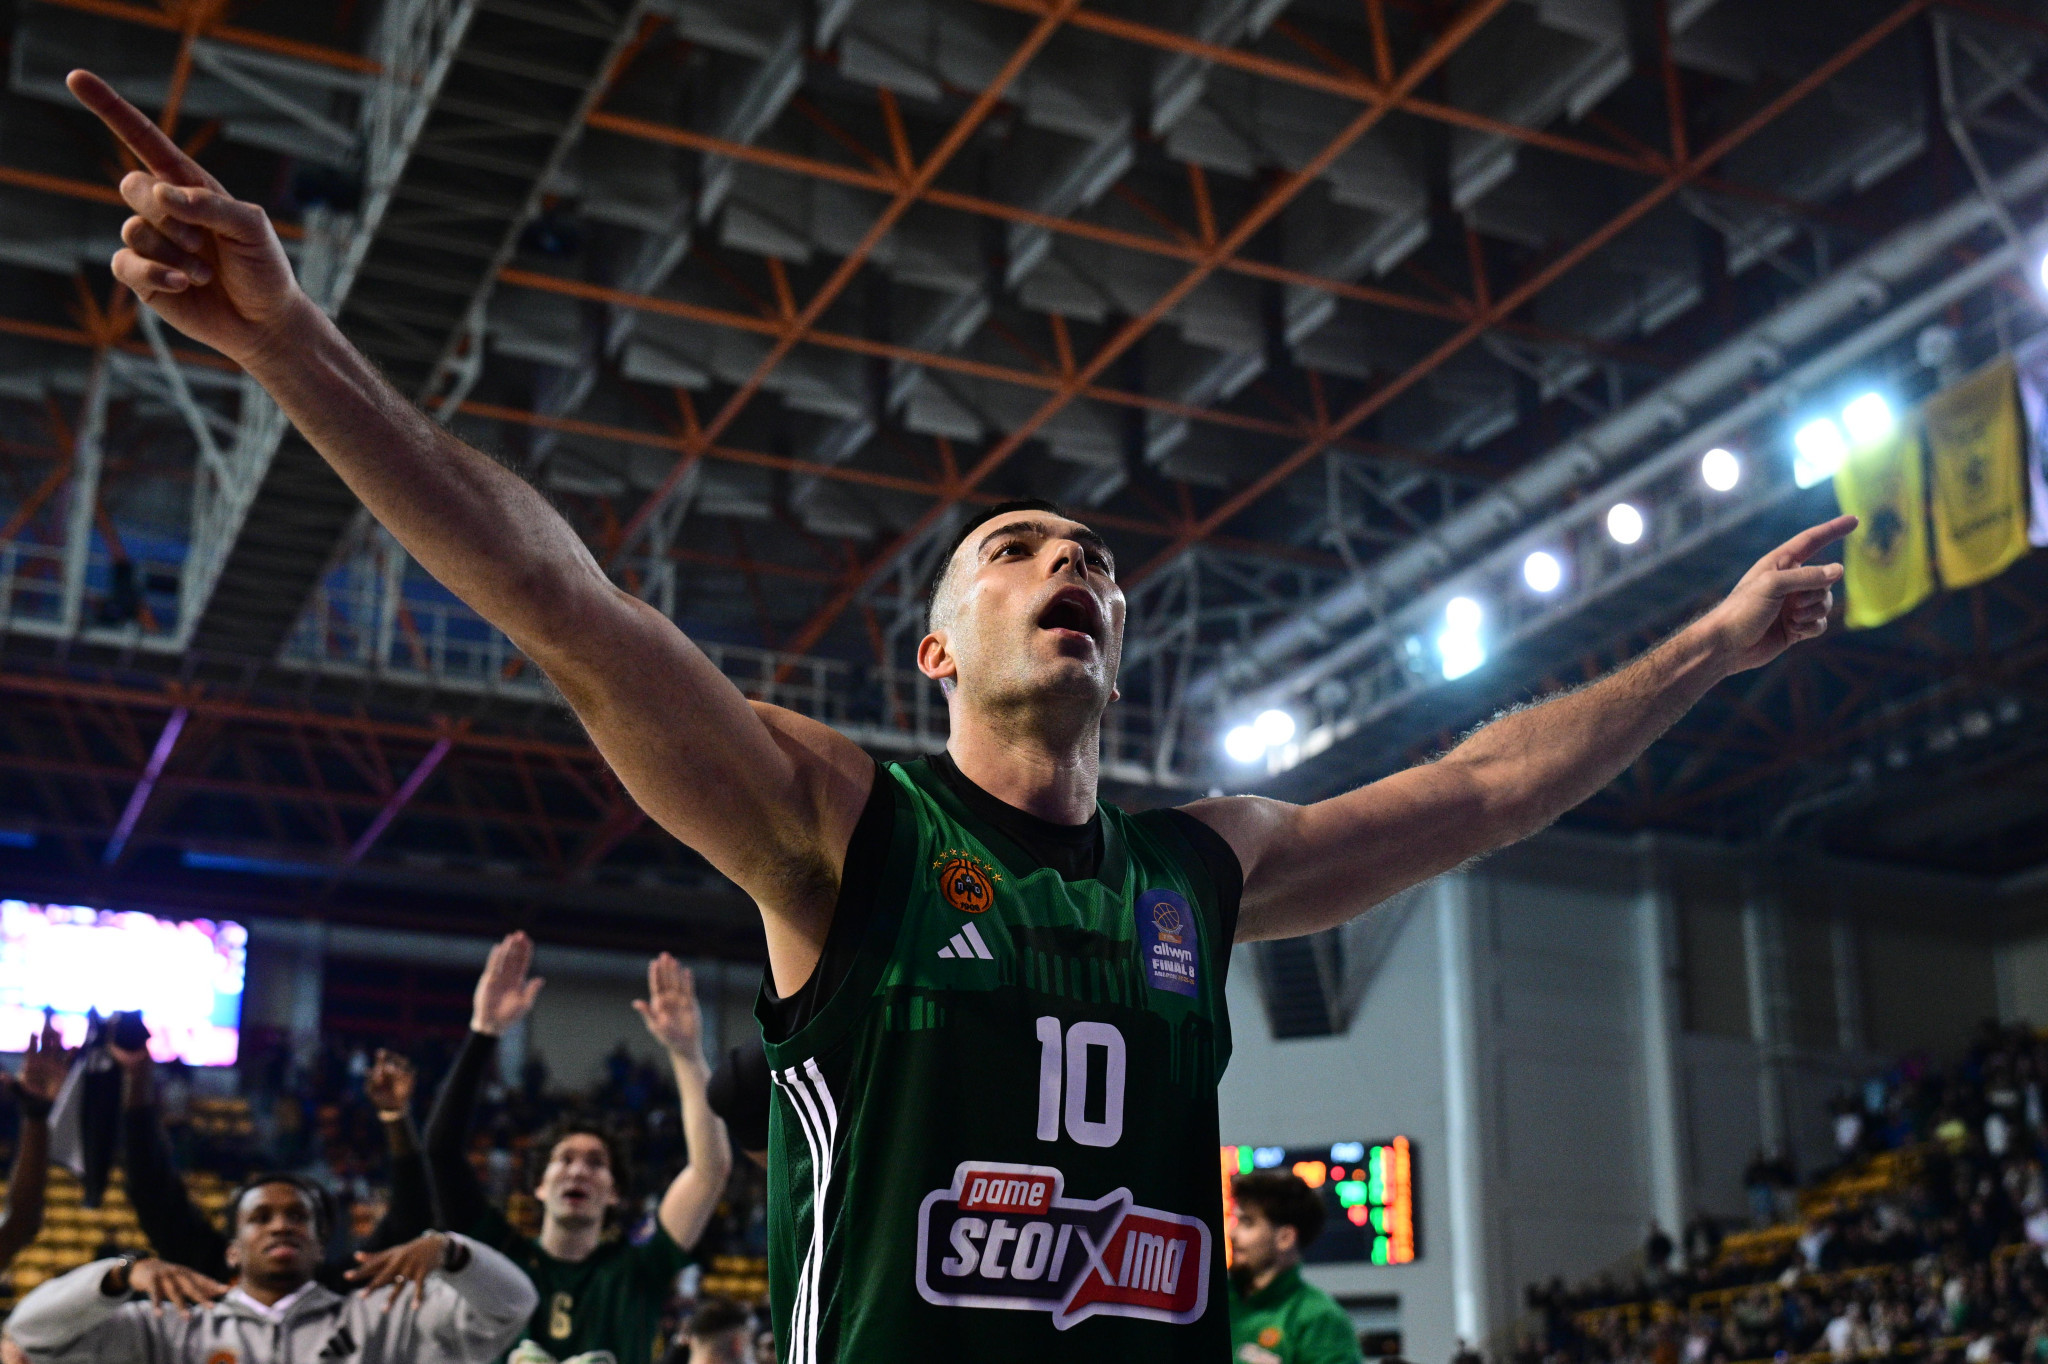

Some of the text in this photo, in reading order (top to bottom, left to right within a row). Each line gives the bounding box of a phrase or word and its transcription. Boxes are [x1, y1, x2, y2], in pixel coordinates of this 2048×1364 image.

[1153, 943, 1191, 963] allwyn
[1152, 959, 1187, 975] FINAL
[1189, 966, 1195, 977] 8
[1036, 1015, 1126, 1148] 10
[967, 1178, 1046, 1207] pame
[550, 1292, 572, 1339] 6
